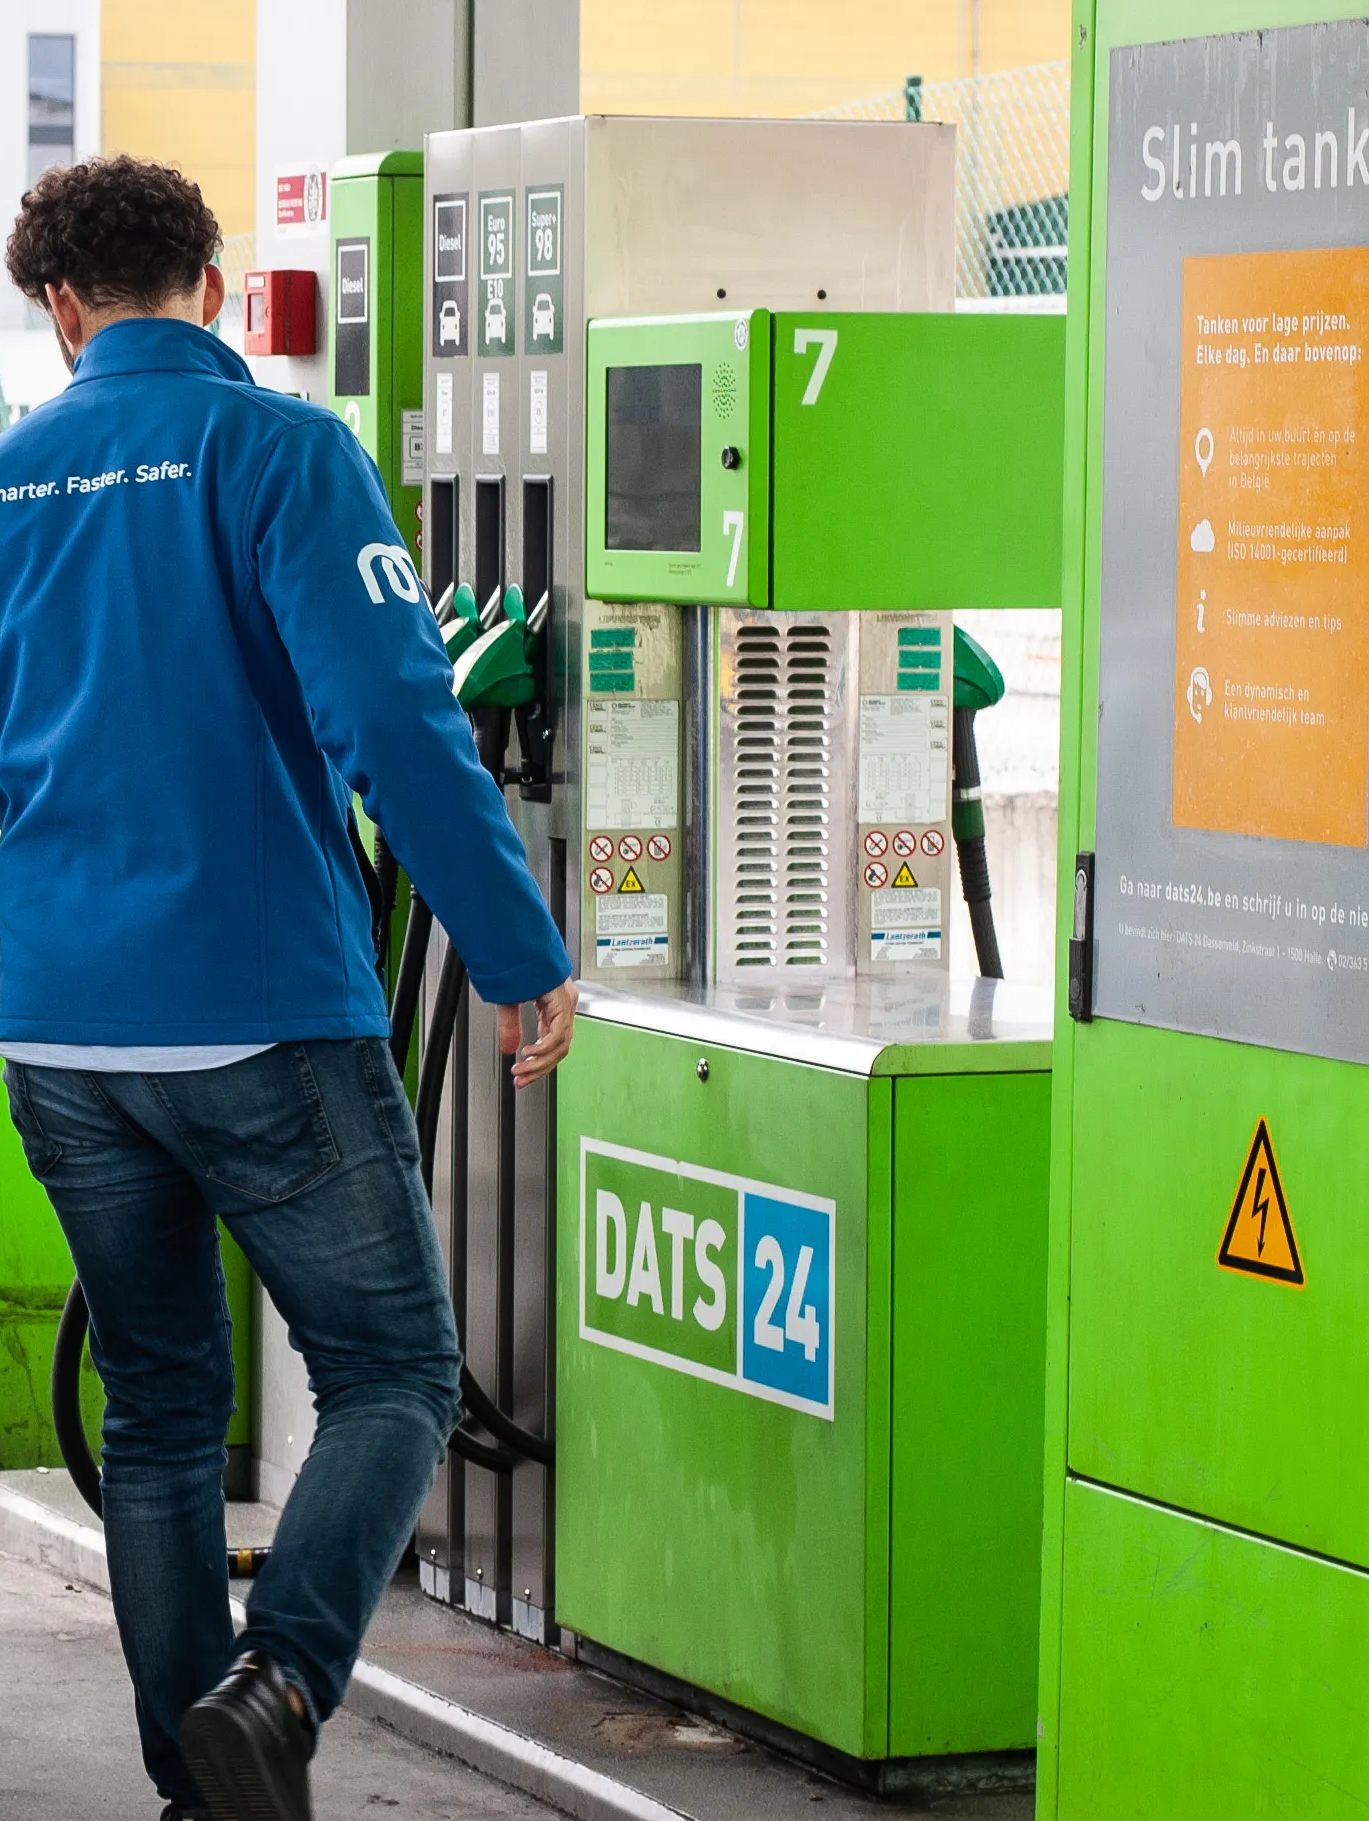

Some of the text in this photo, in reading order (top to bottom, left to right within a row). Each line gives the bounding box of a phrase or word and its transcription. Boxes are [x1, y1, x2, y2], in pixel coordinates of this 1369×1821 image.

[1141, 107, 1369, 202] Slim tank
[487, 214, 506, 232] Euro
[532, 211, 557, 229] Super+
[438, 233, 462, 252] Diesel
[487, 233, 505, 265] 95
[535, 228, 553, 261] 98
[341, 276, 363, 294] Diesel
[487, 279, 504, 299] E10
[1197, 310, 1350, 336] Tanken voor lage prijzen.
[794, 328, 838, 406] 7
[1196, 342, 1363, 368] Elke dag. En daar bovenop:
[1230, 426, 1254, 448] Altijd
[1256, 427, 1265, 442] in
[1268, 431, 1281, 442] uw
[1285, 428, 1310, 443] buurt
[1328, 432, 1339, 448] op
[1344, 426, 1356, 443] de
[1230, 450, 1337, 471] belangrijkste trajecten
[66, 470, 129, 495] Faster.
[135, 461, 192, 483] Safer.
[1229, 471, 1270, 493] in België
[1228, 520, 1351, 543] Milieuvriendelijke aanpak
[723, 510, 744, 588] 7
[1227, 542, 1247, 560] (ISO
[1226, 608, 1343, 635] Slimme adviezen en tips
[1224, 679, 1310, 702] Een dynamisch en
[1224, 701, 1325, 728] klantvriendelijk team
[1120, 874, 1369, 928] Ga naar dats24.be en schrijf u in op de nie
[1118, 922, 1124, 936] U
[1176, 930, 1193, 946] DATS
[1194, 934, 1203, 948] 24
[1287, 948, 1303, 962] 1500
[596, 1188, 727, 1331] DATS
[754, 1234, 820, 1363] 24
